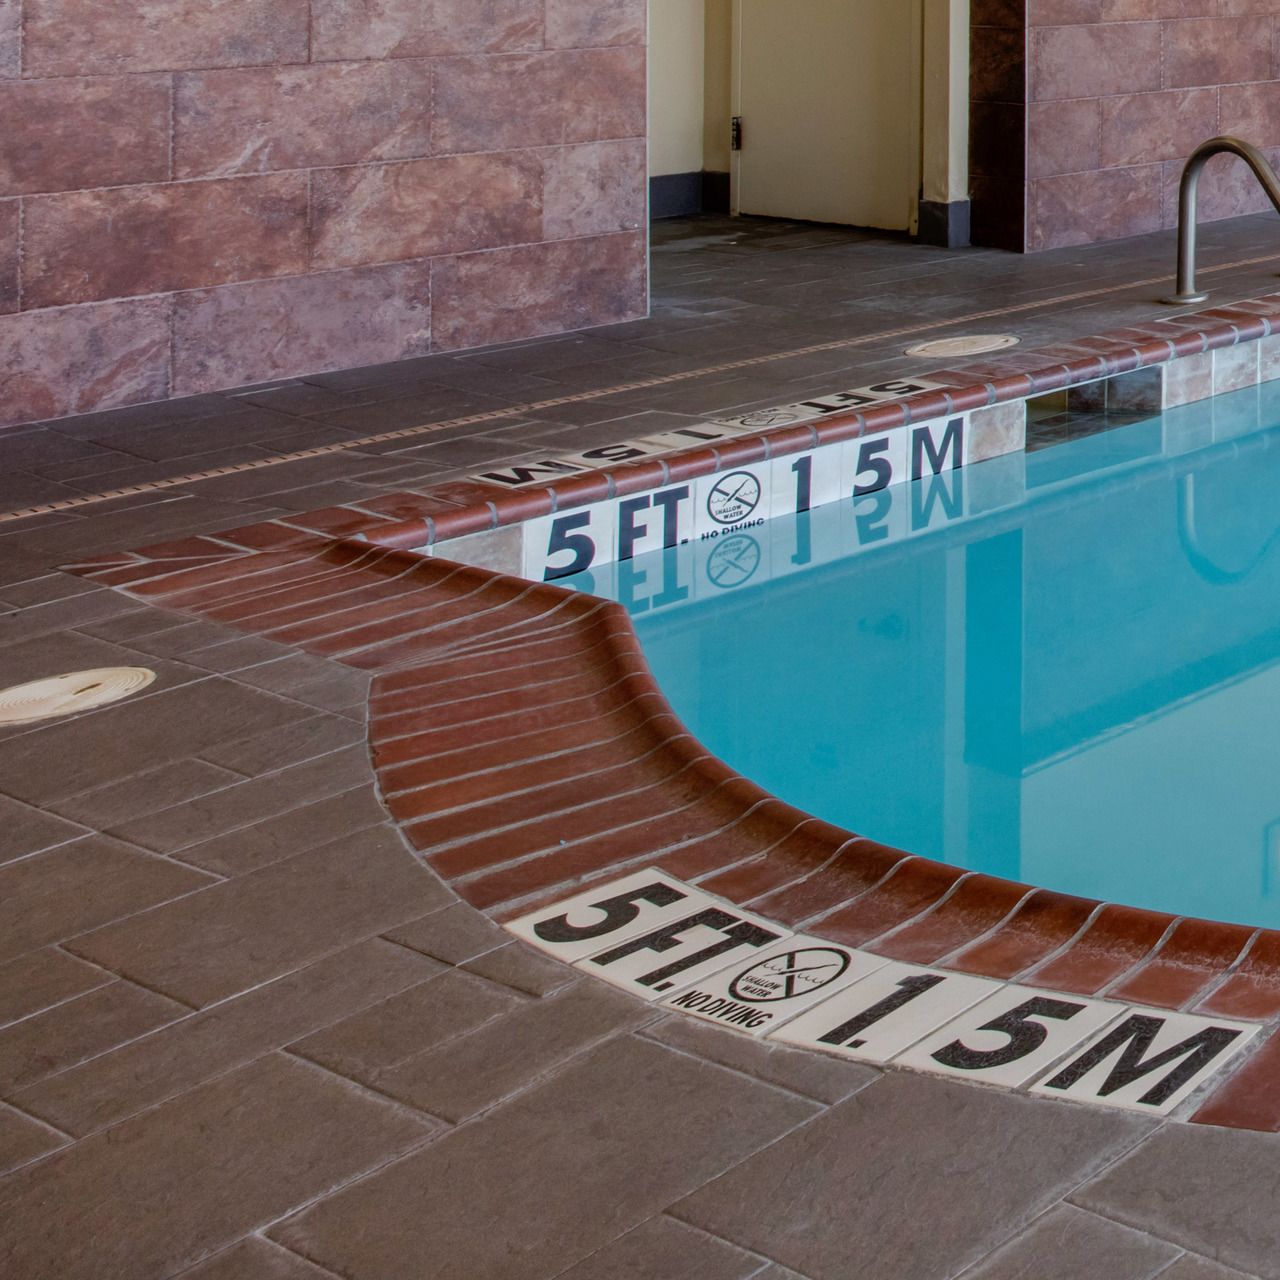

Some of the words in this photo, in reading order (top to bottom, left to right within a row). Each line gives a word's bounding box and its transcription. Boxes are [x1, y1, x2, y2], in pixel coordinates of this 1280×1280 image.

[742, 975, 784, 990] SHALLOW
[741, 985, 772, 998] WATER
[670, 990, 708, 1009] NO
[698, 997, 774, 1028] DIVING
